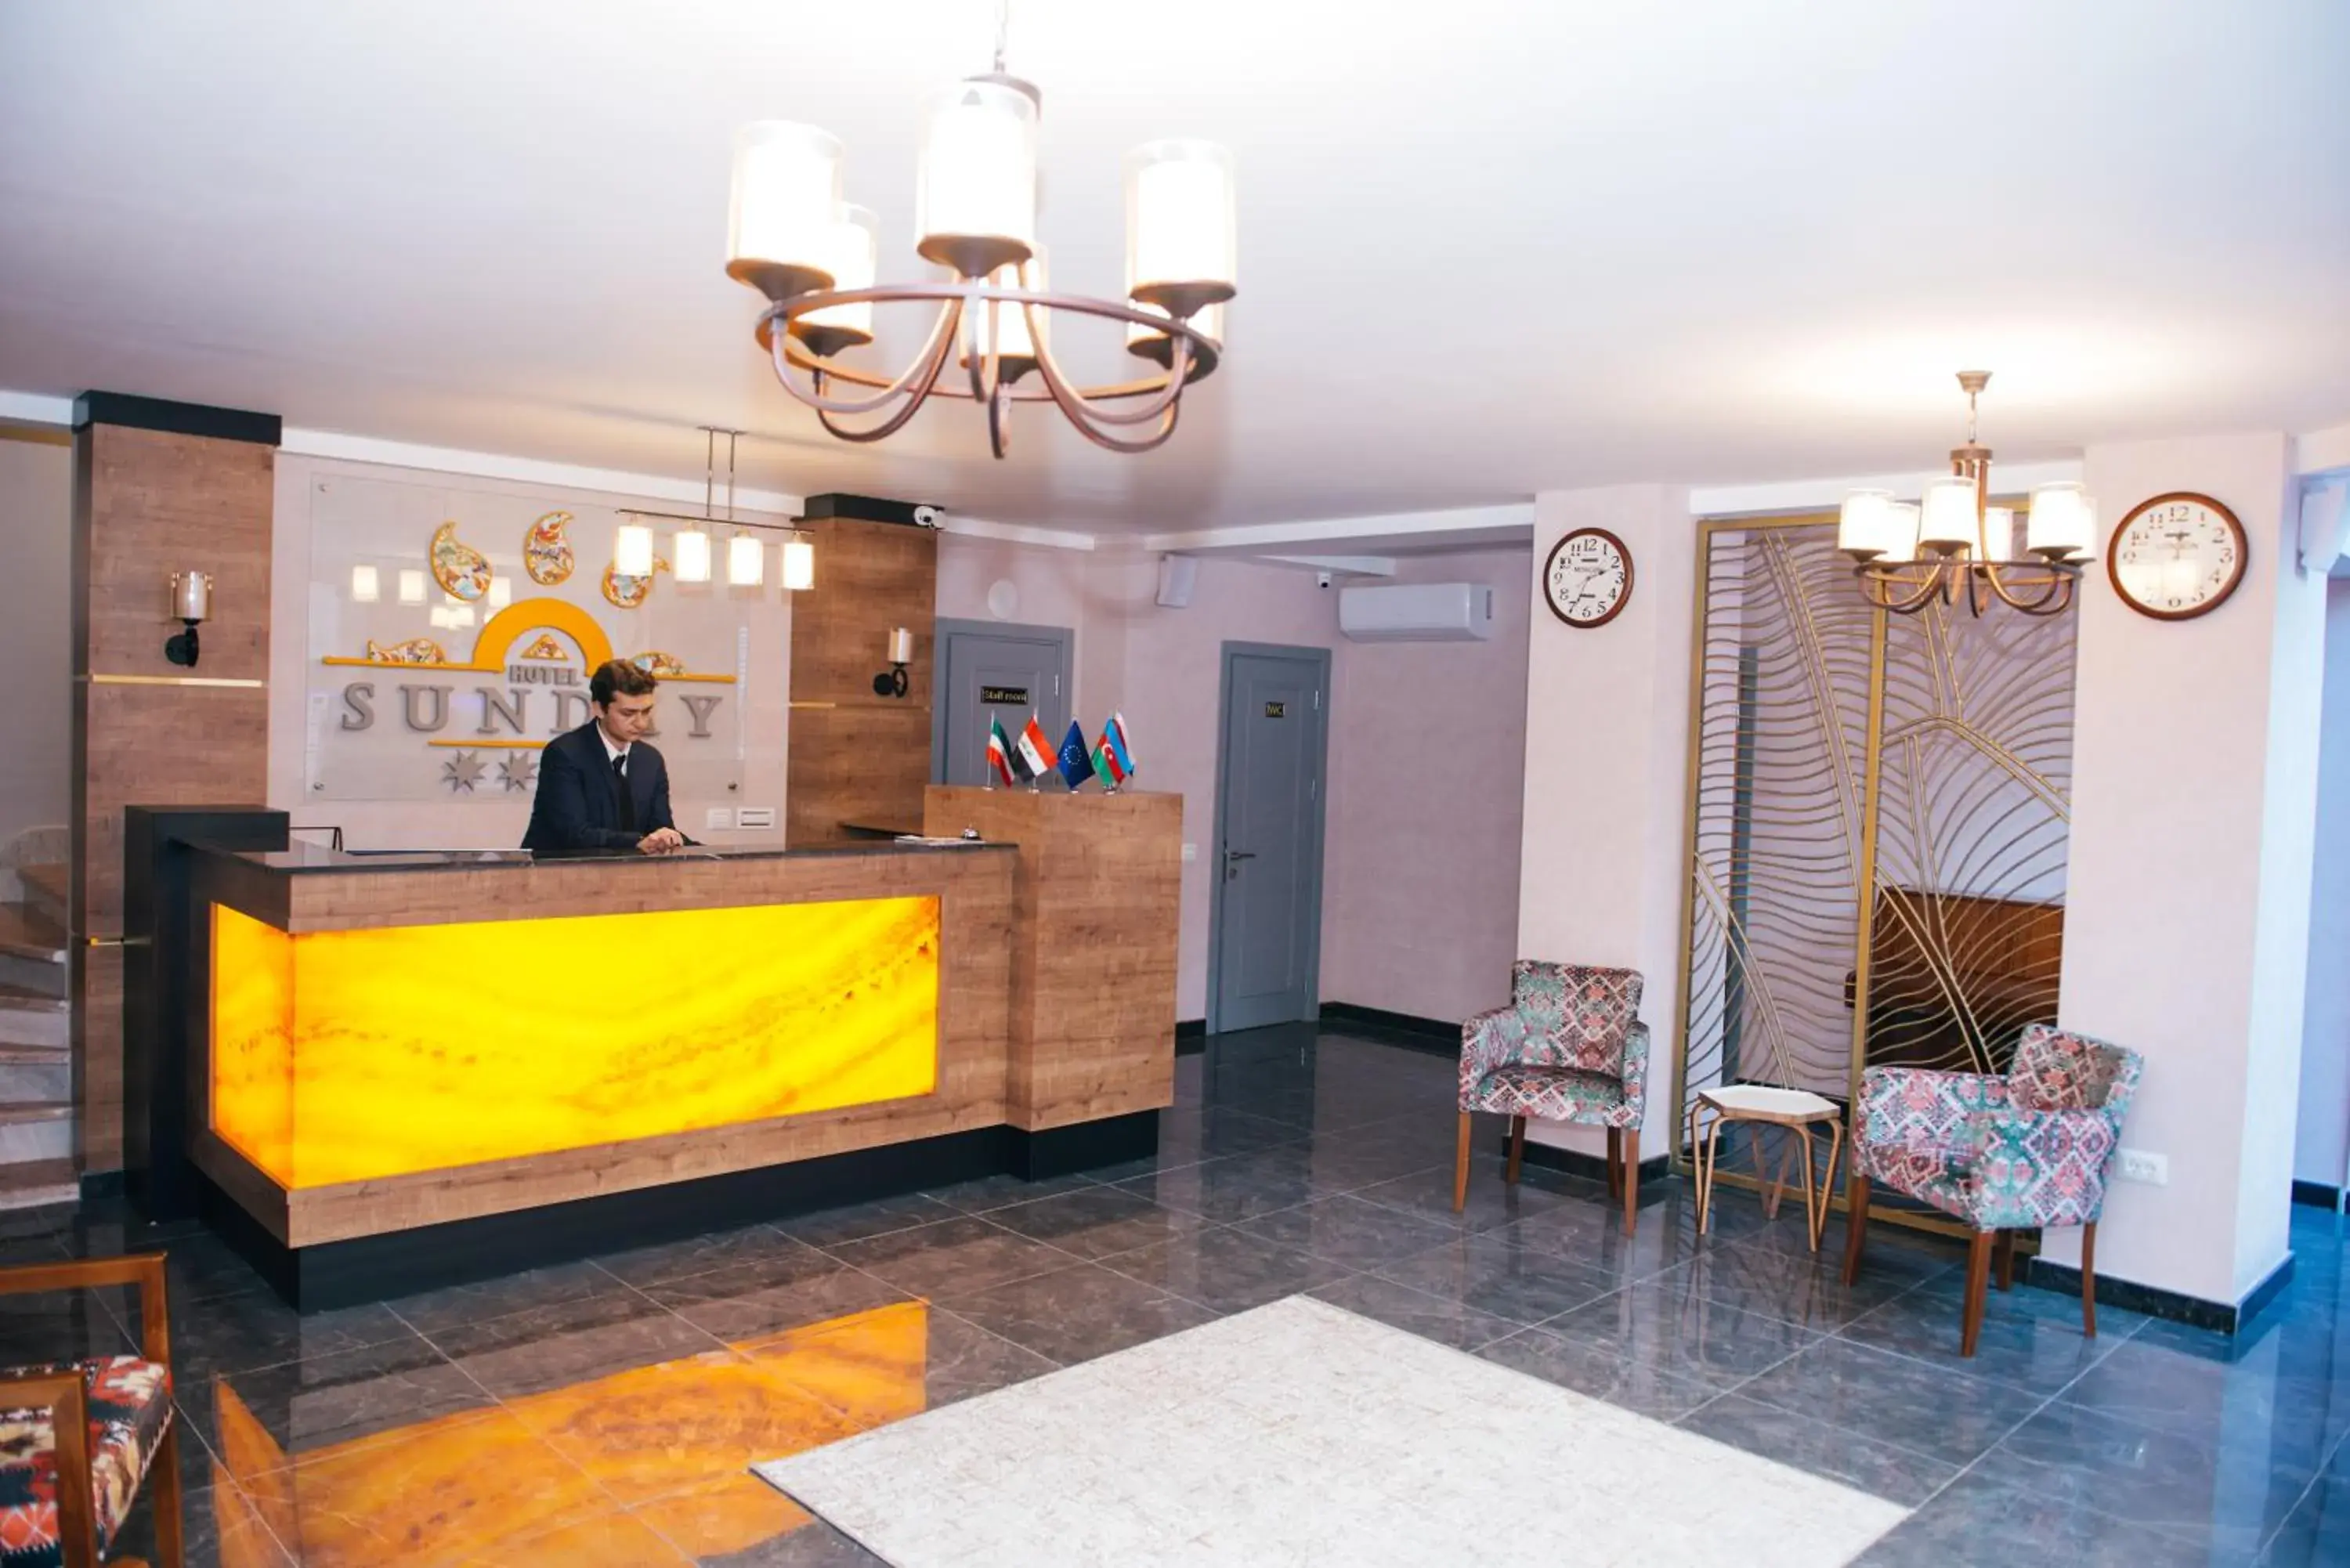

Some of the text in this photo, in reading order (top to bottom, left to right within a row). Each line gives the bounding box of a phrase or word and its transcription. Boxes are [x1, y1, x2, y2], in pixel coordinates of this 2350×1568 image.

[2169, 506, 2189, 522] 12
[2199, 511, 2206, 527] 1
[2149, 514, 2164, 529] 11
[2212, 527, 2225, 544] 2
[1571, 544, 1581, 557] 11
[1584, 539, 1597, 552] 12
[1603, 543, 1608, 555] 1
[1611, 555, 1620, 569] 2
[2219, 548, 2233, 564] 3
[1560, 557, 1571, 569] 10
[1554, 572, 1563, 584] 9
[1615, 572, 1625, 584] 3
[1560, 587, 1569, 601] 8
[1608, 587, 1617, 600] 4
[1582, 605, 1592, 618] 6
[1597, 602, 1607, 614] 5
[508, 664, 582, 687] HOTEL
[342, 682, 723, 739] SUNDY
